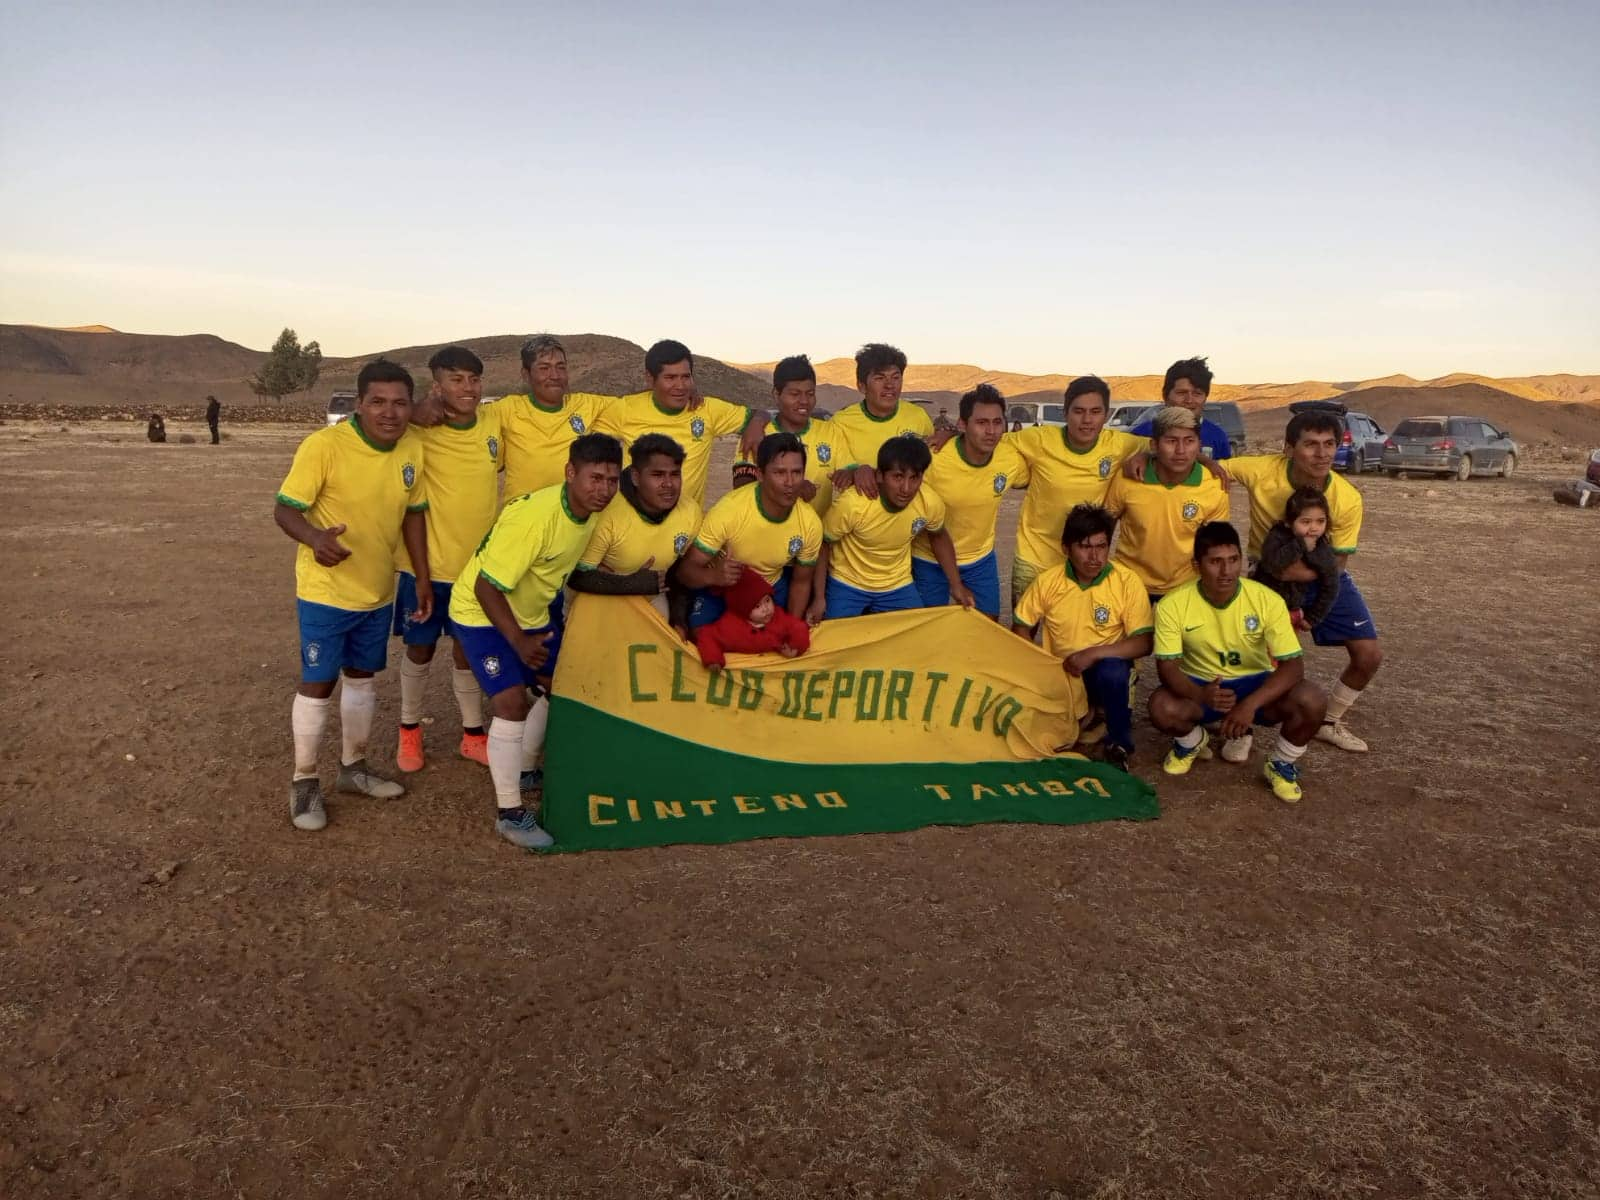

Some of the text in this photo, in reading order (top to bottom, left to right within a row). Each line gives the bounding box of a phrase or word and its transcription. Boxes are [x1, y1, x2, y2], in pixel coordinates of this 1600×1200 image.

[628, 644, 1022, 736] CLUB DEPORTIVO
[588, 777, 1111, 826] CINTENO TAMBO
